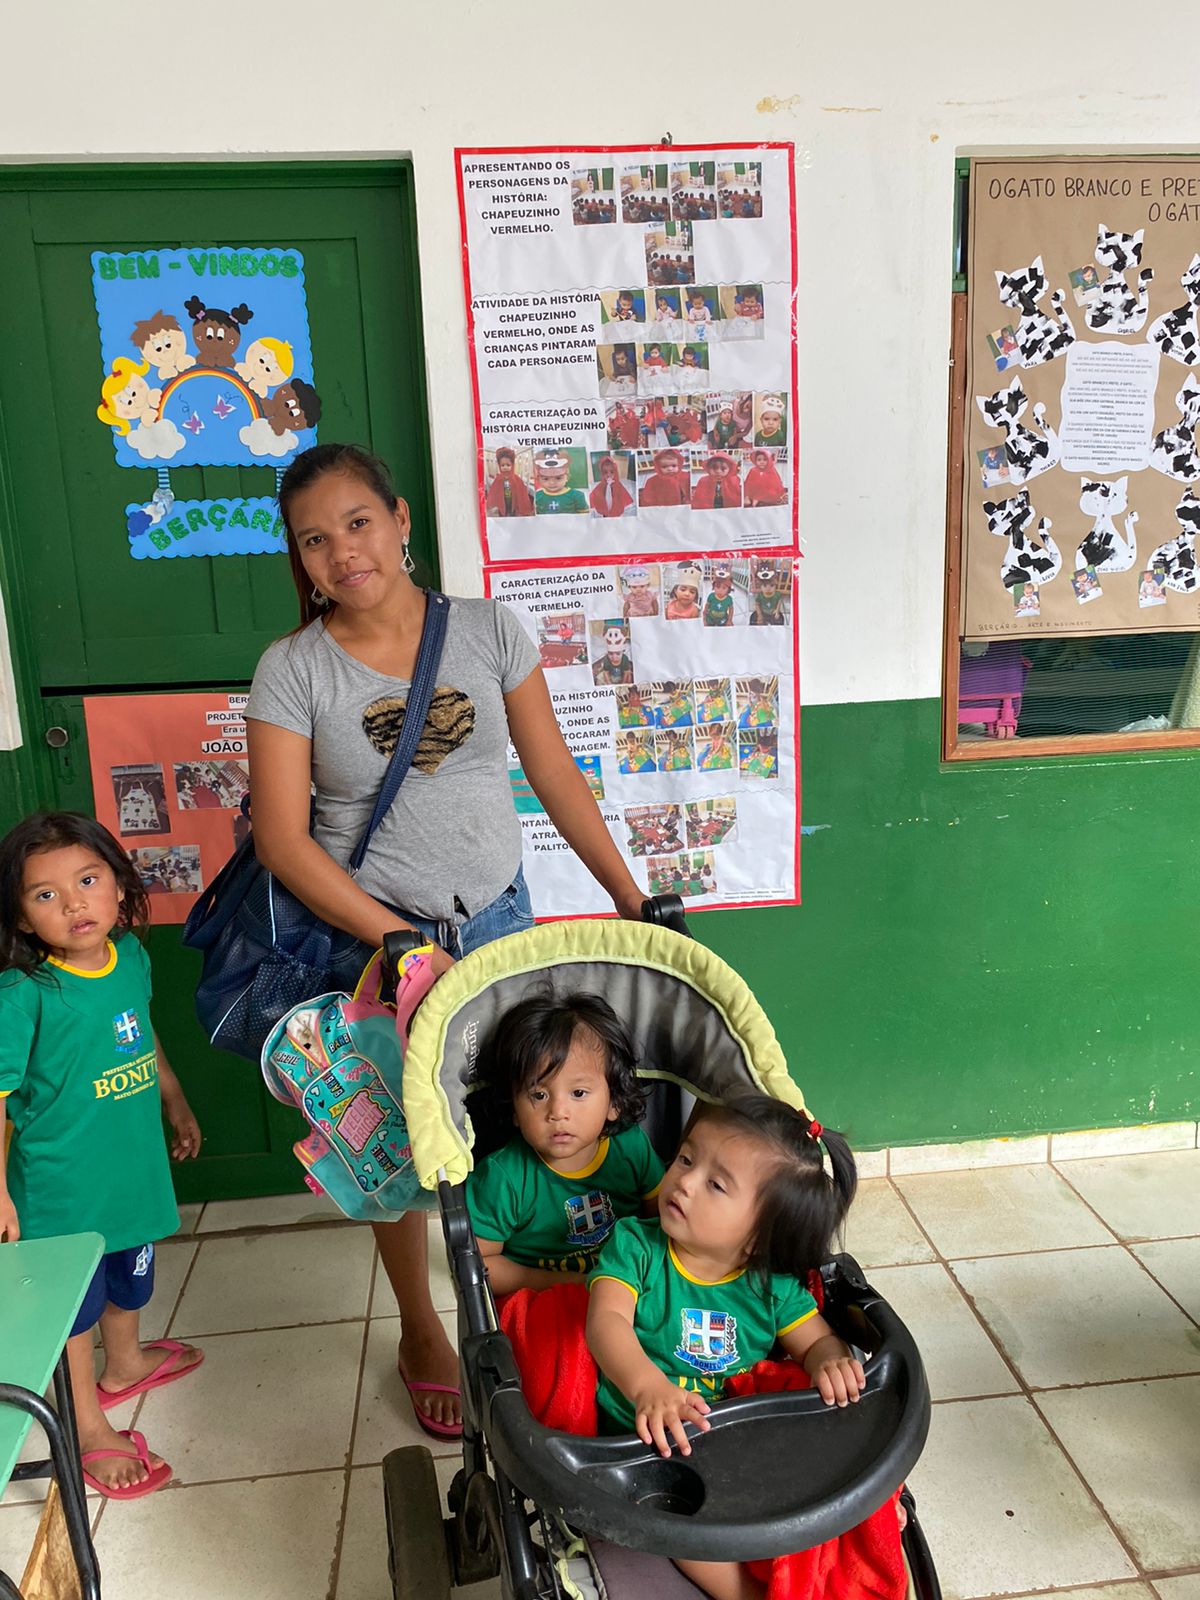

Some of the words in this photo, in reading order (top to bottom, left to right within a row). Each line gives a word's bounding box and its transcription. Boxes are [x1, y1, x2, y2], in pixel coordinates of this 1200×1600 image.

[464, 162, 552, 173] APRESENTANDO
[556, 161, 570, 169] OS
[469, 178, 550, 188] PERSONAGENS
[1065, 177, 1131, 197] BRANCO
[1142, 179, 1152, 196] E
[1162, 178, 1200, 197] PRE
[492, 192, 547, 203] HISTÓRIA:
[482, 208, 560, 219] CHAPEUZINHO
[1166, 202, 1200, 221] GAT
[491, 225, 553, 234] VERMELHO.
[100, 255, 160, 280] BEM
[188, 253, 298, 278] VINDOS
[472, 298, 529, 309] ATIVIDADE
[550, 293, 600, 304] HISTÓRIA
[500, 311, 576, 322] CHAPEUZINHO
[484, 329, 545, 338] VERMELHO,
[548, 326, 577, 335] ONDE
[484, 343, 538, 353] CRIANÇAS
[542, 340, 596, 350] PINTARAM
[488, 359, 516, 368] CADA
[520, 355, 595, 366] PERSONAGEM.
[489, 407, 580, 418] CARACTERIZAÇÃO
[482, 422, 531, 433] HISTÓRIA
[534, 422, 605, 431] CHAPEUZINHO
[518, 437, 572, 446] VERMELHO
[149, 500, 287, 551] BERÇÁRI
[501, 572, 588, 588] CARACTERIZAÇÃO
[495, 590, 541, 602] HISTÓRIA
[544, 585, 614, 598] CHAPEUZINHO
[528, 601, 583, 612] VERMELHO.
[569, 690, 615, 700] HISTÓRIA
[555, 705, 593, 715] UZINHO
[567, 718, 594, 726] ONDE
[562, 729, 610, 740] TOCARAM
[202, 740, 242, 753] JOÃO
[92, 1057, 158, 1099] BONIT
